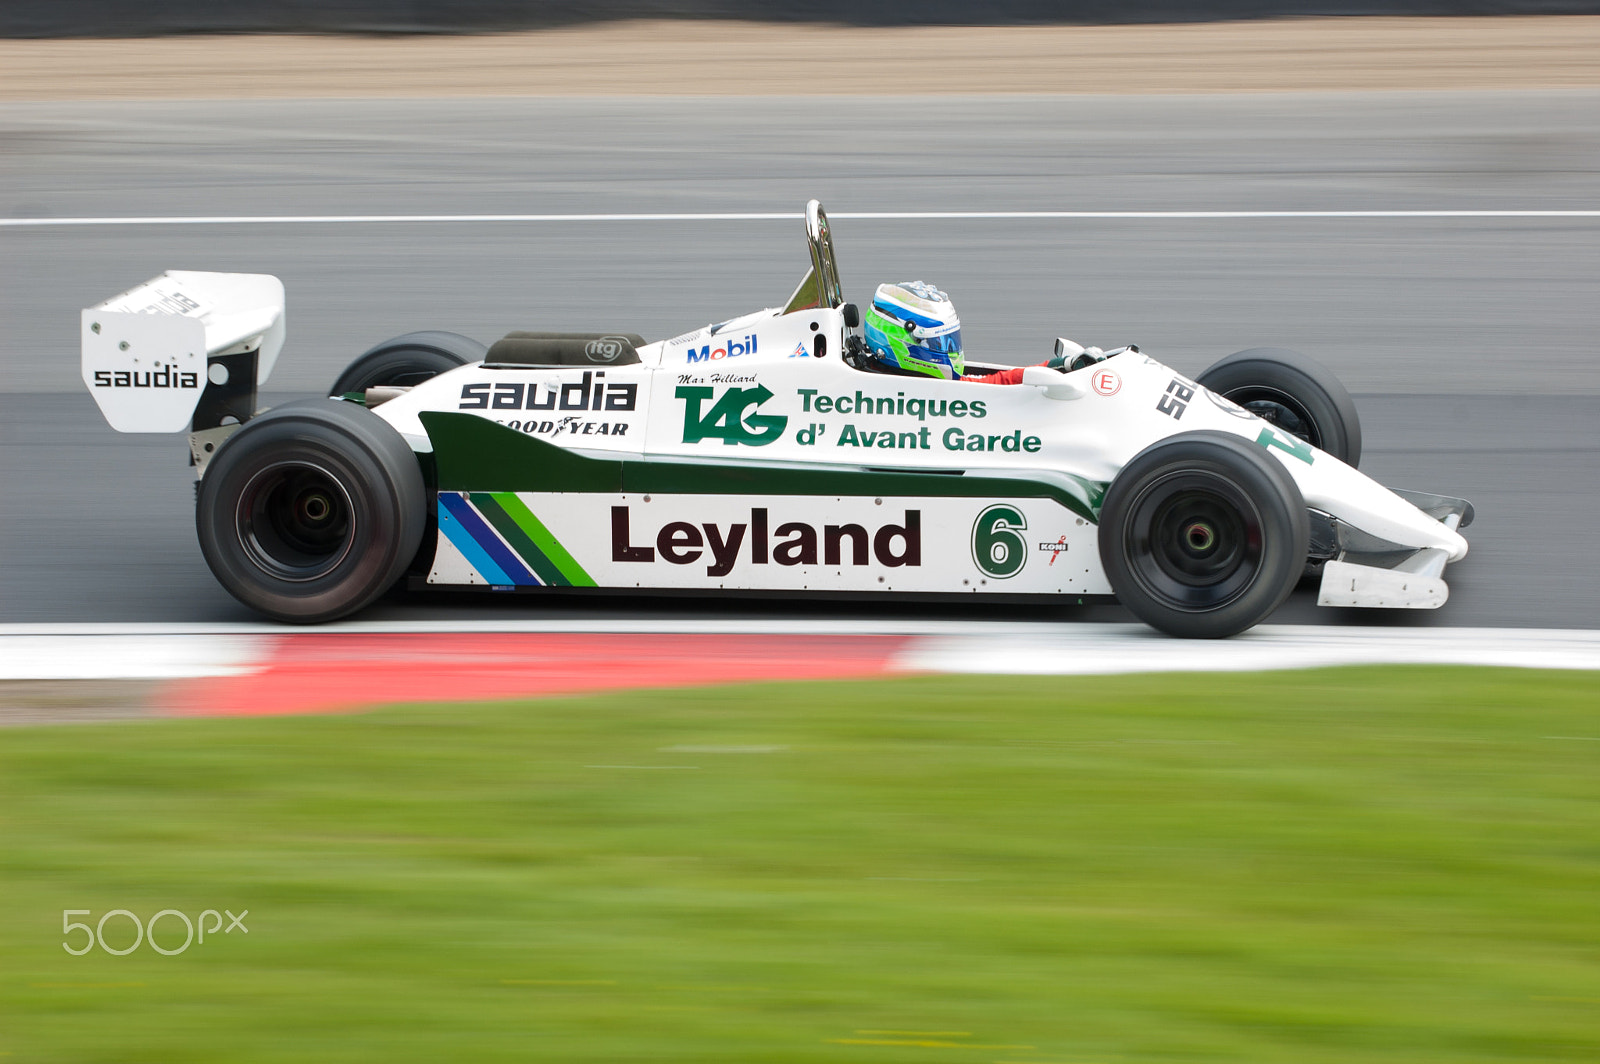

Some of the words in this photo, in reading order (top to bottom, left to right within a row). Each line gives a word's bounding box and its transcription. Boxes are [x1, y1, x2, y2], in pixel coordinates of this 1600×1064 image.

[590, 341, 617, 358] itg
[686, 334, 758, 364] Mobil
[94, 364, 198, 389] saudia
[459, 371, 638, 411] saudia
[710, 373, 758, 384] Hilliard
[674, 382, 789, 447] TAG
[797, 388, 988, 421] Techniques
[836, 424, 932, 450] Avant
[941, 427, 1042, 453] Garde
[610, 505, 922, 578] Leyland
[970, 503, 1029, 580] 6
